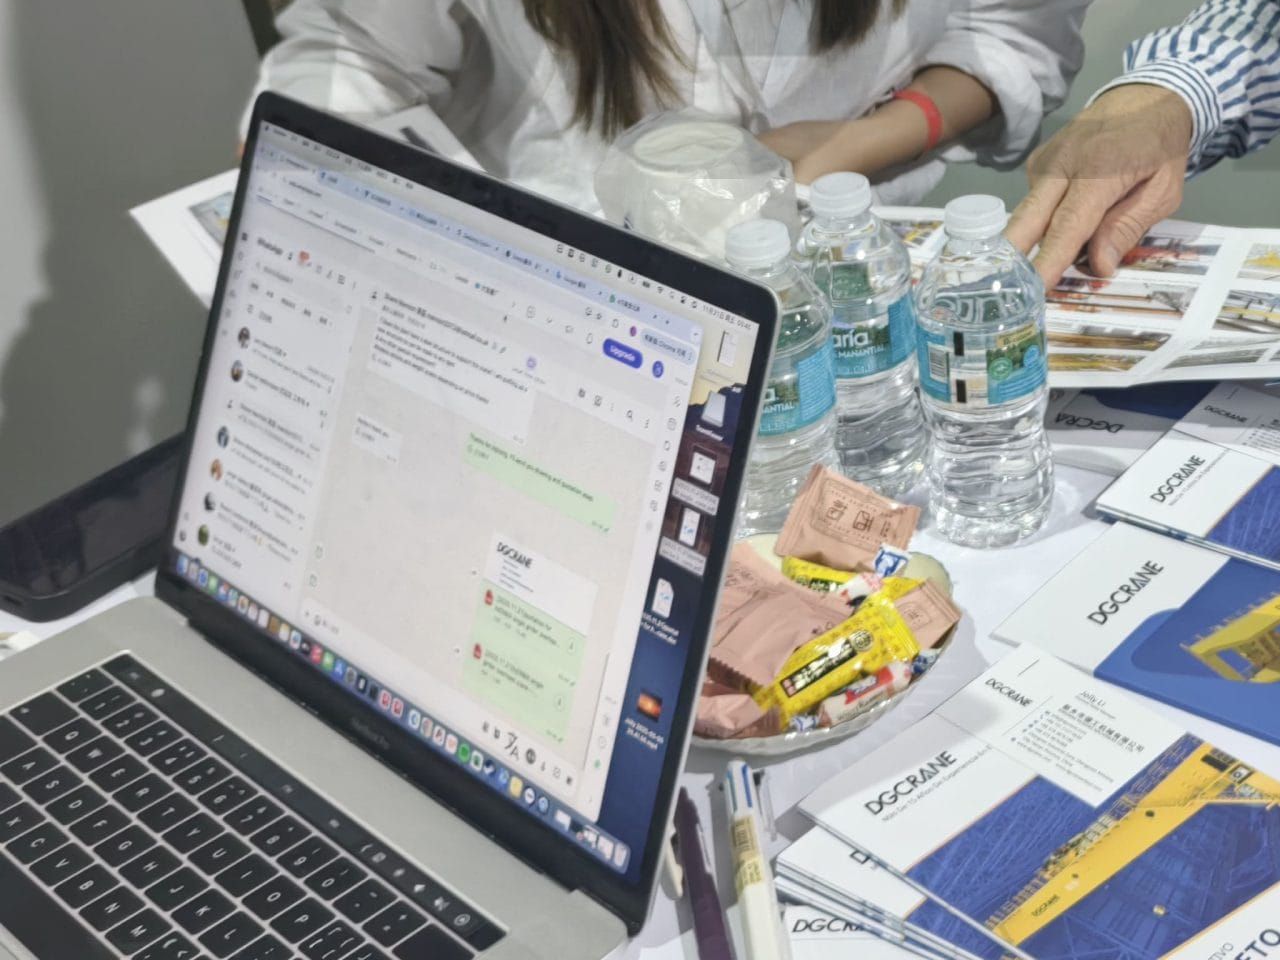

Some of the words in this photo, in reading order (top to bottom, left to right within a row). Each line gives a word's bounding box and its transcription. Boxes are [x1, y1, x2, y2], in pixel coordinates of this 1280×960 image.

[1150, 455, 1206, 503] DGCRANE
[1087, 560, 1164, 625] DGCRANE
[985, 678, 1034, 707] DGCRANE
[864, 750, 957, 816] DGCRANE
